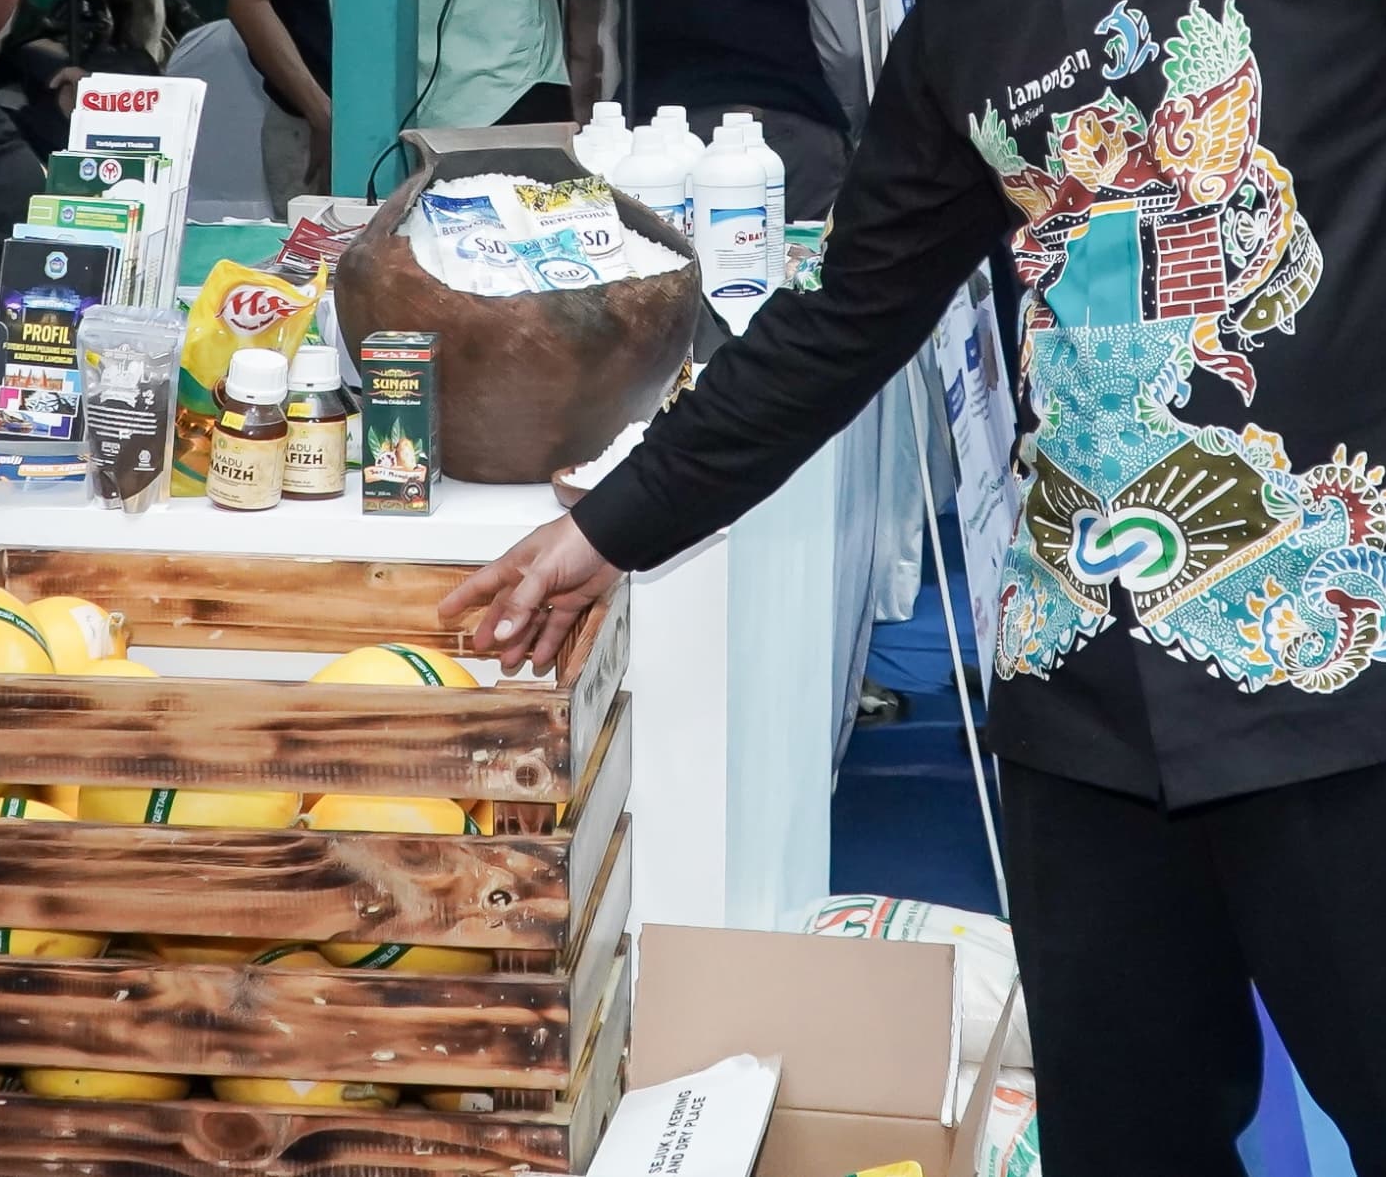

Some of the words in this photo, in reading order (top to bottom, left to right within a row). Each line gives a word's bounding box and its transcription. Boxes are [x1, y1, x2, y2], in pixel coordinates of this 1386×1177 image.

[22, 323, 71, 344] PROFIL
[372, 378, 420, 391] SUNAN
[683, 1096, 707, 1129] PLACE
[648, 1139, 673, 1174] SEJUK
[666, 1090, 693, 1129] KERING
